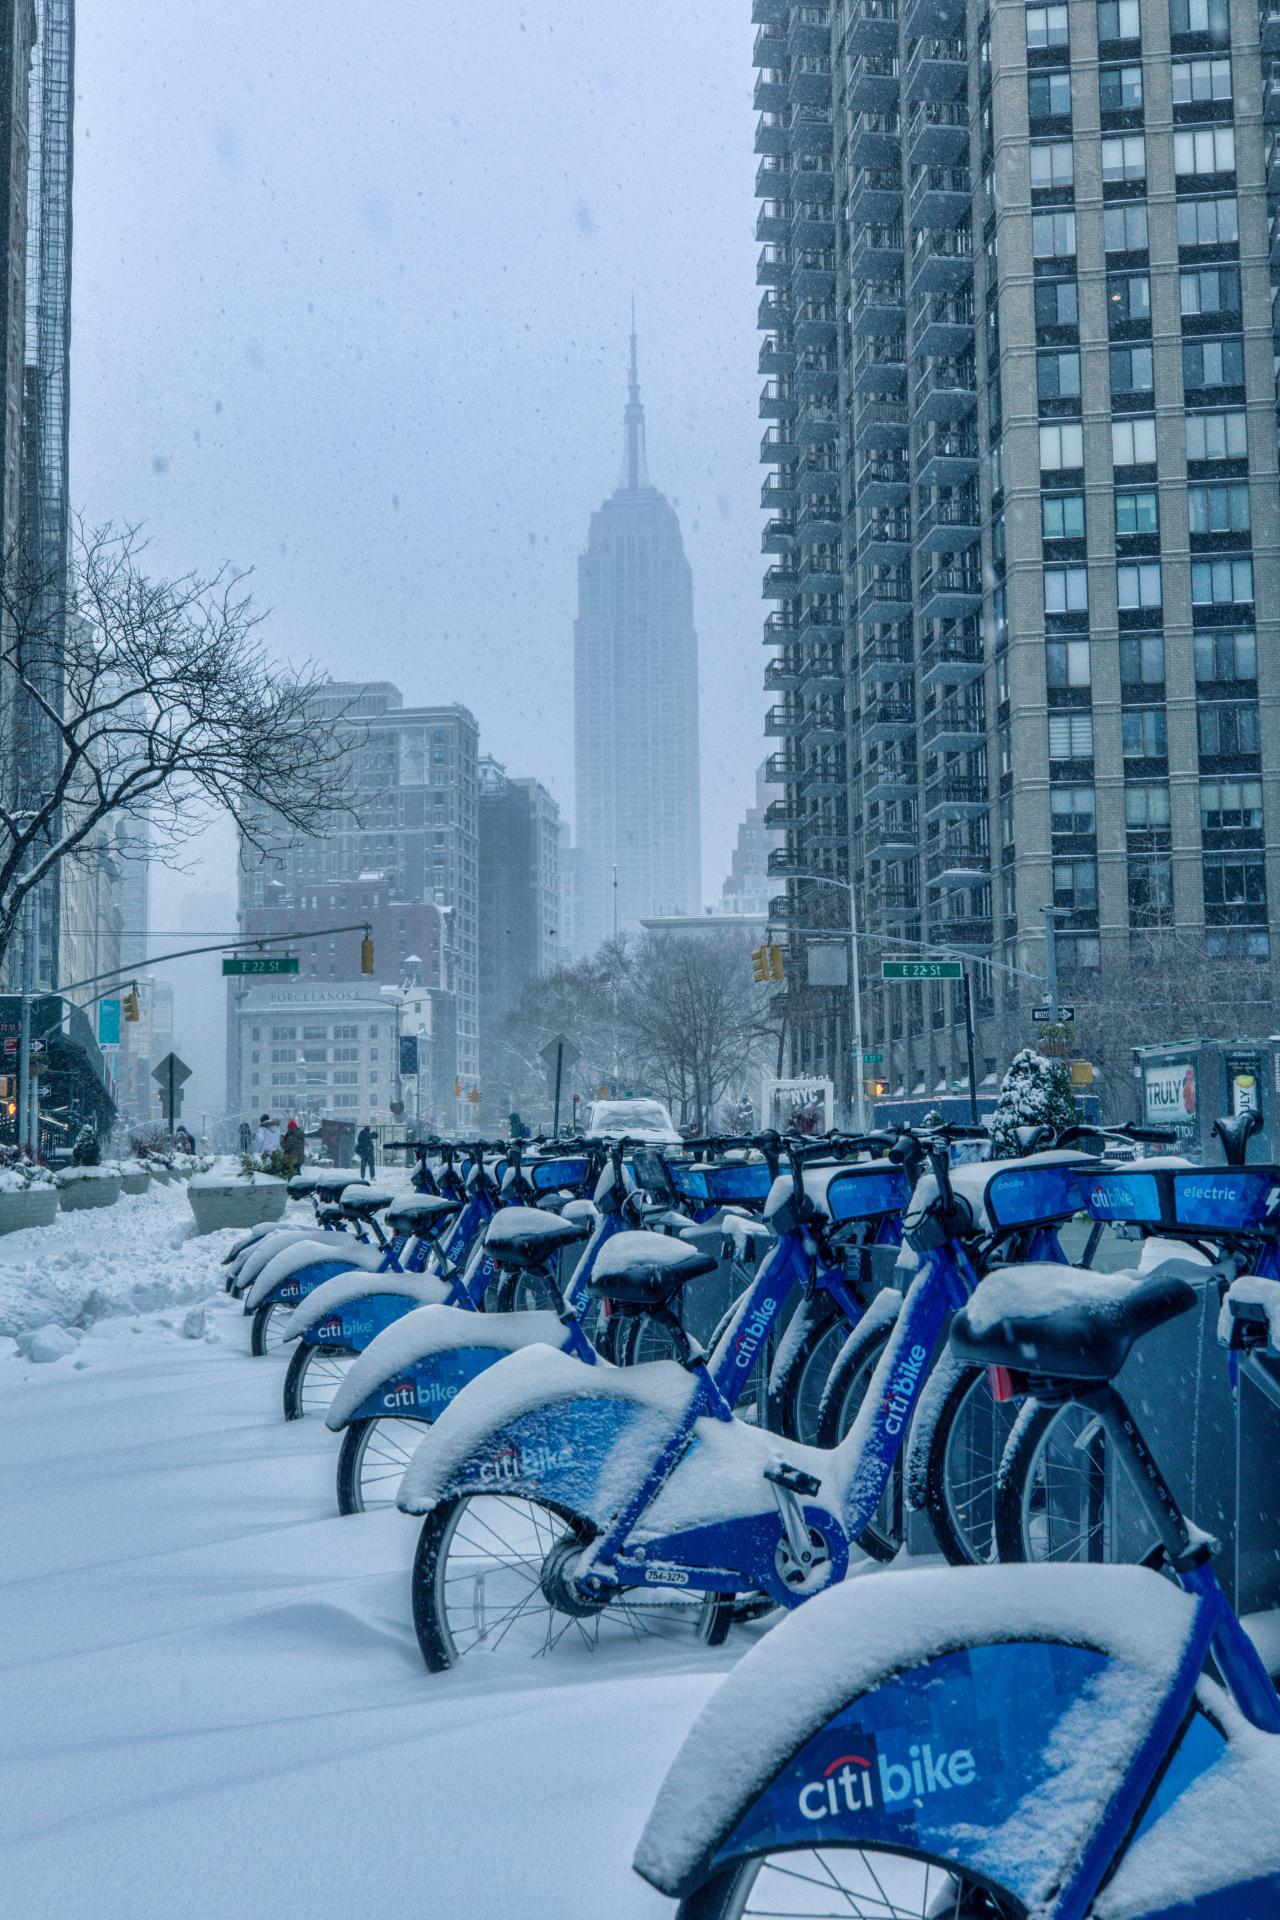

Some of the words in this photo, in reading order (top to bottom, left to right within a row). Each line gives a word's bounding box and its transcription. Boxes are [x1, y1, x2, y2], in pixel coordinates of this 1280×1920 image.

[242, 961, 249, 972] E
[252, 961, 265, 972] 22
[268, 961, 280, 972] St
[902, 965, 909, 976] E
[913, 965, 927, 976] 22
[930, 965, 941, 976] St
[271, 991, 360, 1002] PORCELANOSA
[791, 1087, 818, 1105] NYC
[1146, 1079, 1182, 1106] TRULY
[1091, 1187, 1108, 1207] citi
[1109, 1190, 1134, 1207] bike
[1183, 1186, 1236, 1201] electric
[281, 1284, 299, 1297] citi
[575, 1289, 590, 1312] bik
[318, 1321, 341, 1338] citi
[343, 1320, 373, 1336] bike
[744, 1298, 777, 1337] bike
[735, 1335, 758, 1368] citi
[893, 1344, 927, 1396] bike
[384, 1387, 415, 1408] citi
[417, 1383, 457, 1404] bike
[885, 1394, 910, 1435] citi
[481, 1453, 520, 1480] citi
[521, 1446, 574, 1476] bike
[799, 1758, 874, 1820] citi
[877, 1744, 976, 1803] bike
